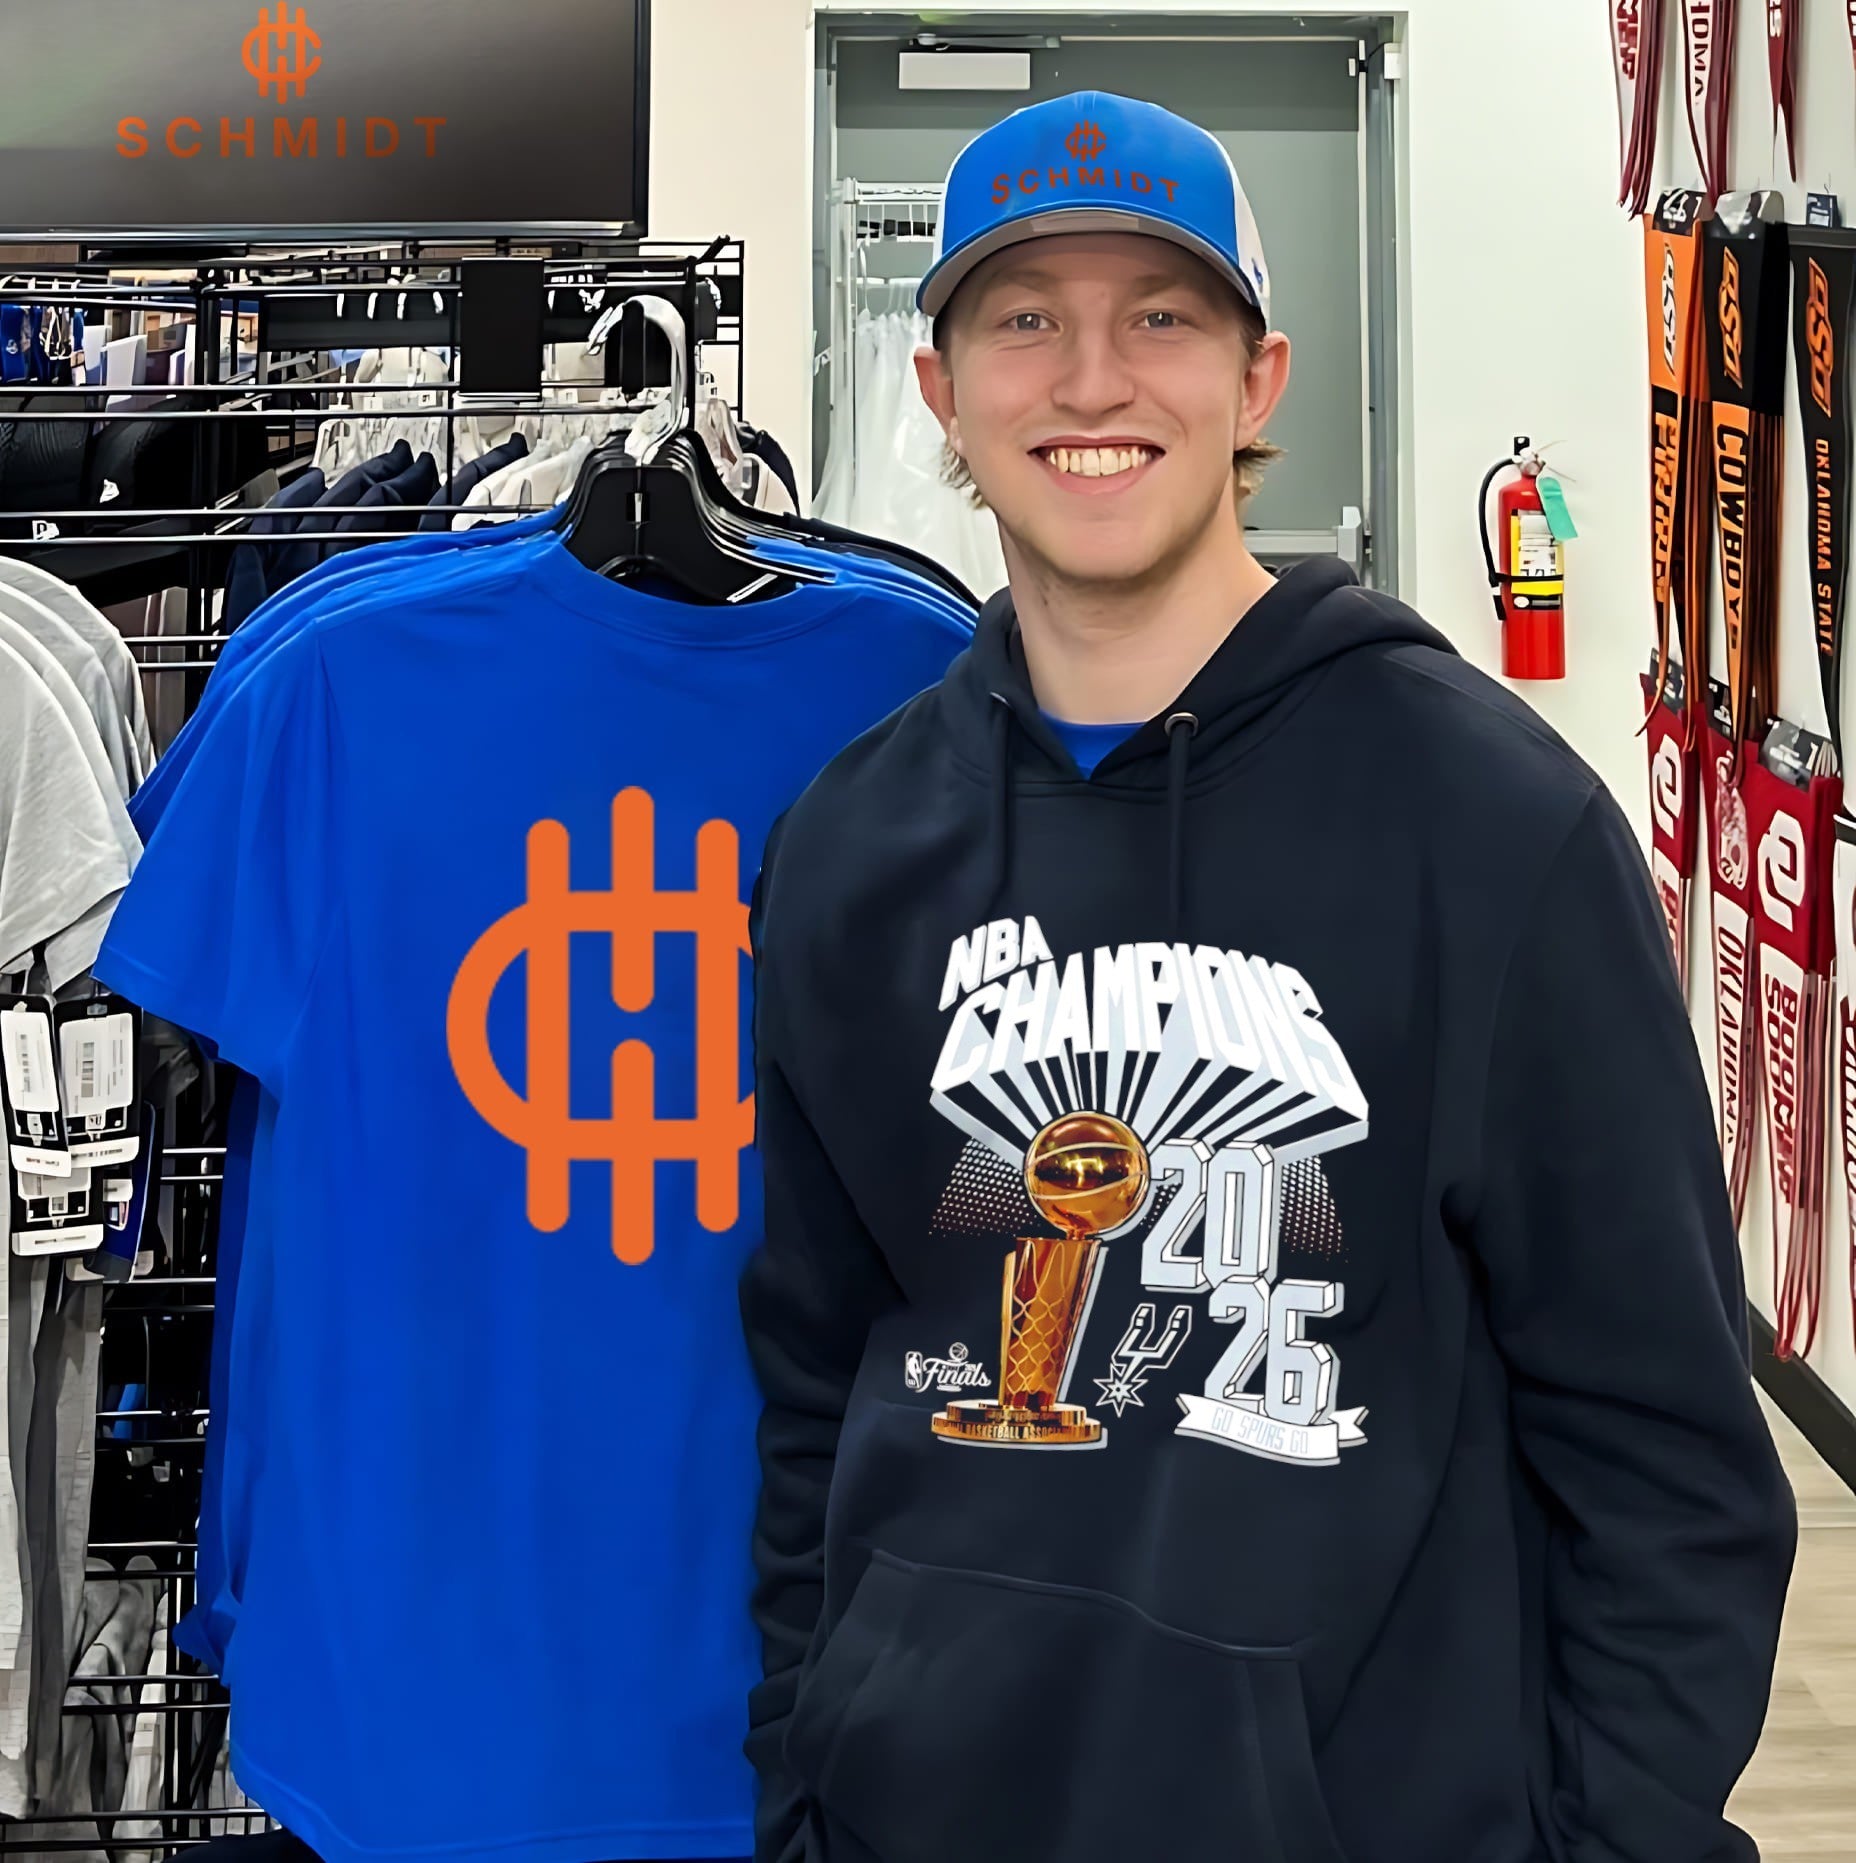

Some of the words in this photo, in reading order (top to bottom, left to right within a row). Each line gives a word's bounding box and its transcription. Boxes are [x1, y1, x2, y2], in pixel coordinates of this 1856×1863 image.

[115, 116, 447, 158] SCHMIDT
[991, 166, 1180, 205] SCHMIDT
[938, 915, 1054, 1011] NBA
[930, 942, 1369, 1122] CHAMPIONS
[1718, 925, 1745, 1144] OKLAHOMA
[922, 1357, 992, 1393] Finals
[1211, 1406, 1234, 1433] GO
[1238, 1415, 1286, 1451] SPURS
[1290, 1430, 1309, 1454] GO
